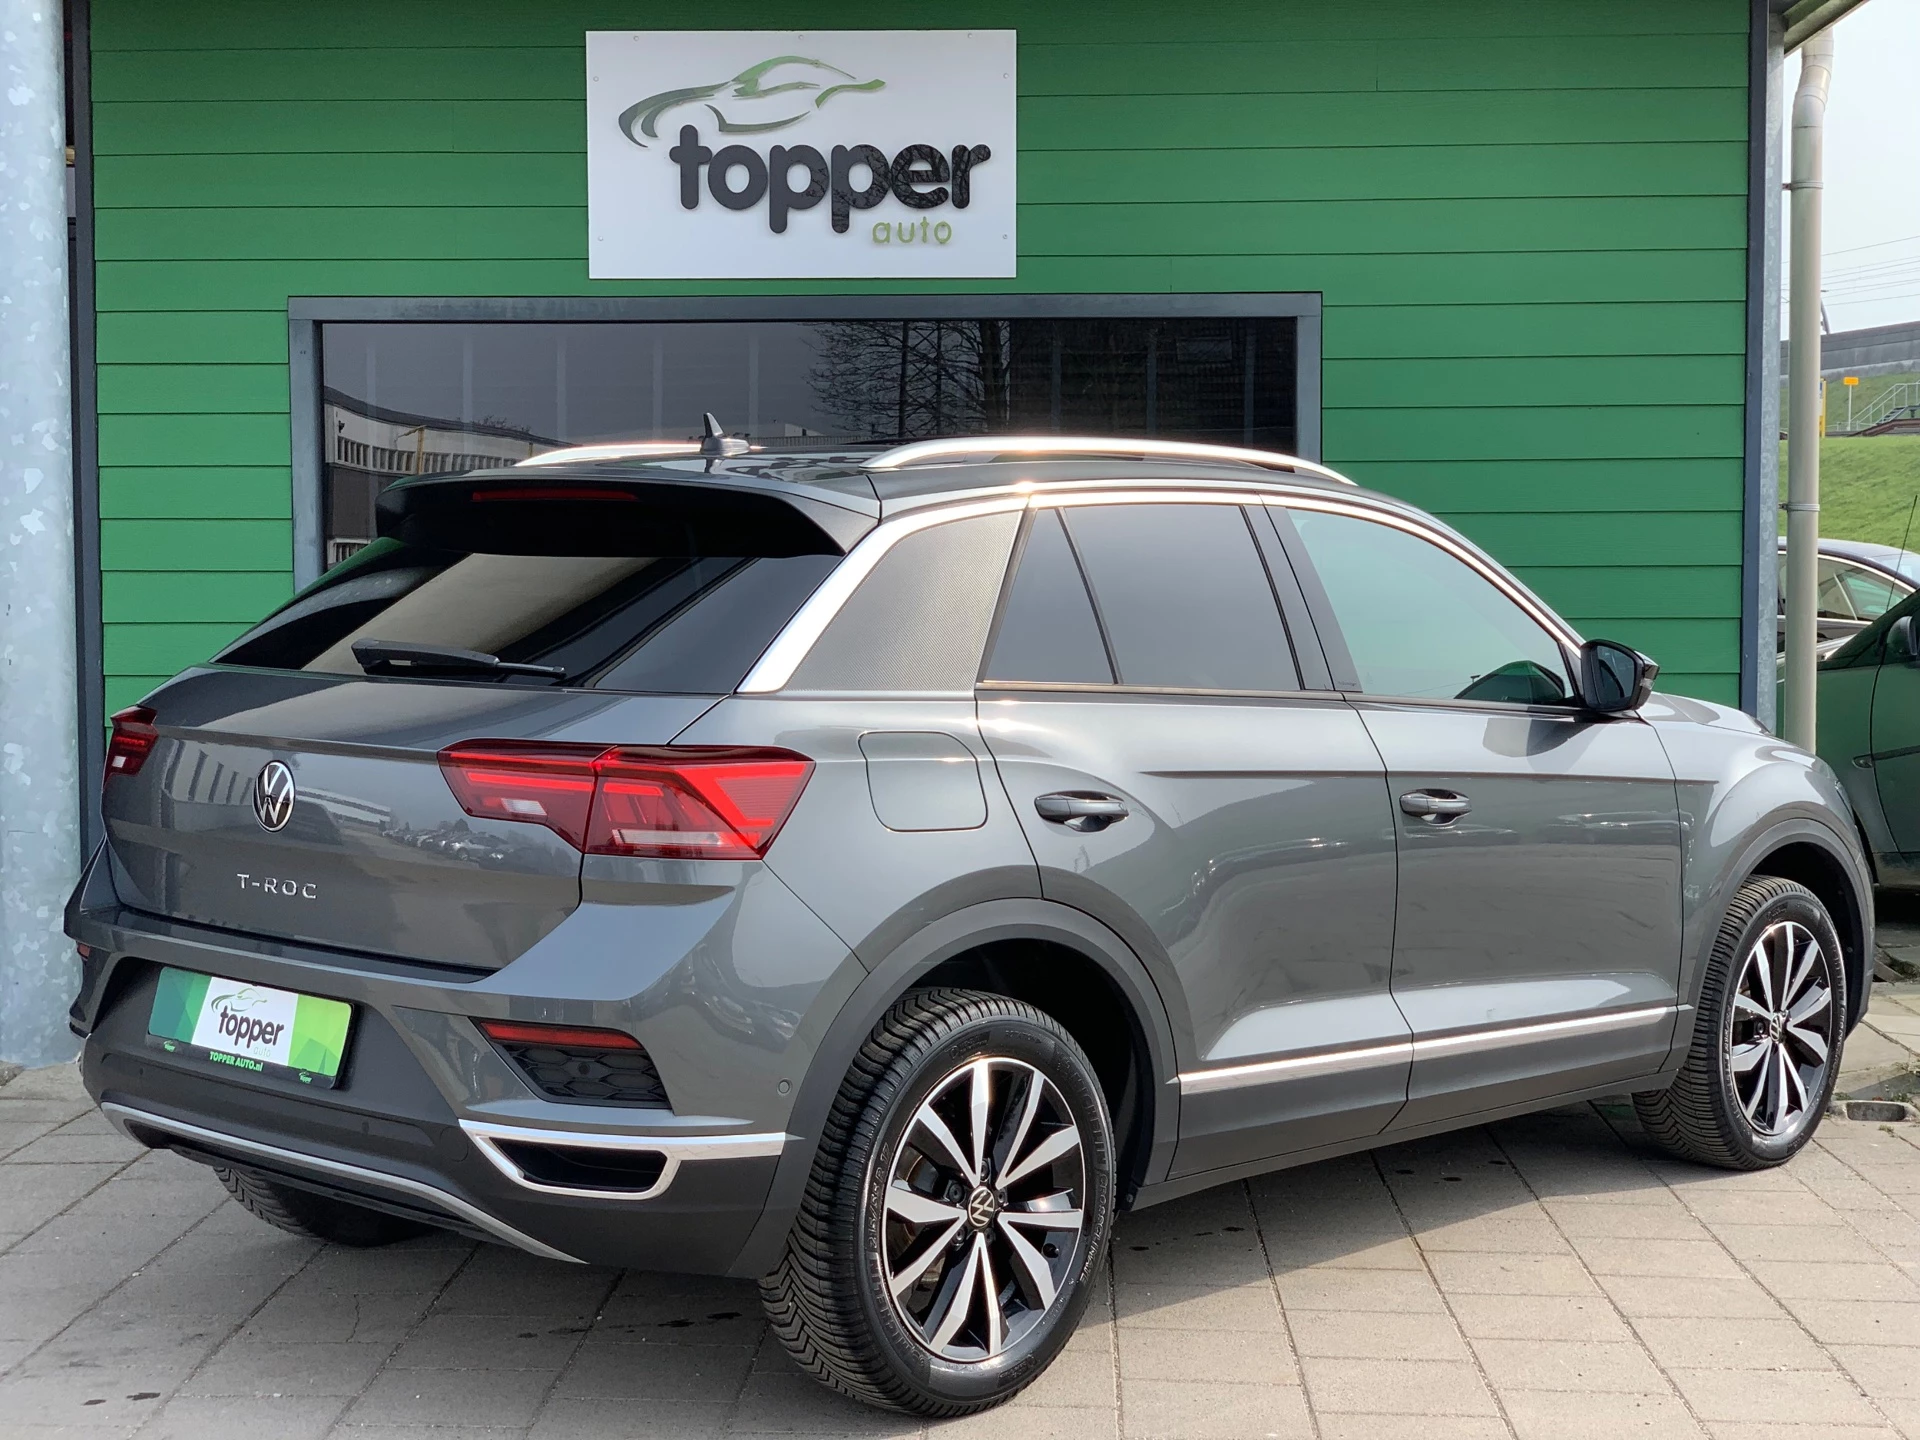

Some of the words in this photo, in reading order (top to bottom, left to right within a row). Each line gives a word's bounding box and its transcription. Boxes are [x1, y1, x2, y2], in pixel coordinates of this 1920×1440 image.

[669, 124, 991, 234] topper
[872, 217, 952, 244] auto
[237, 873, 318, 900] T-ROC
[218, 1005, 285, 1049] topper
[209, 1050, 235, 1066] TOPPER
